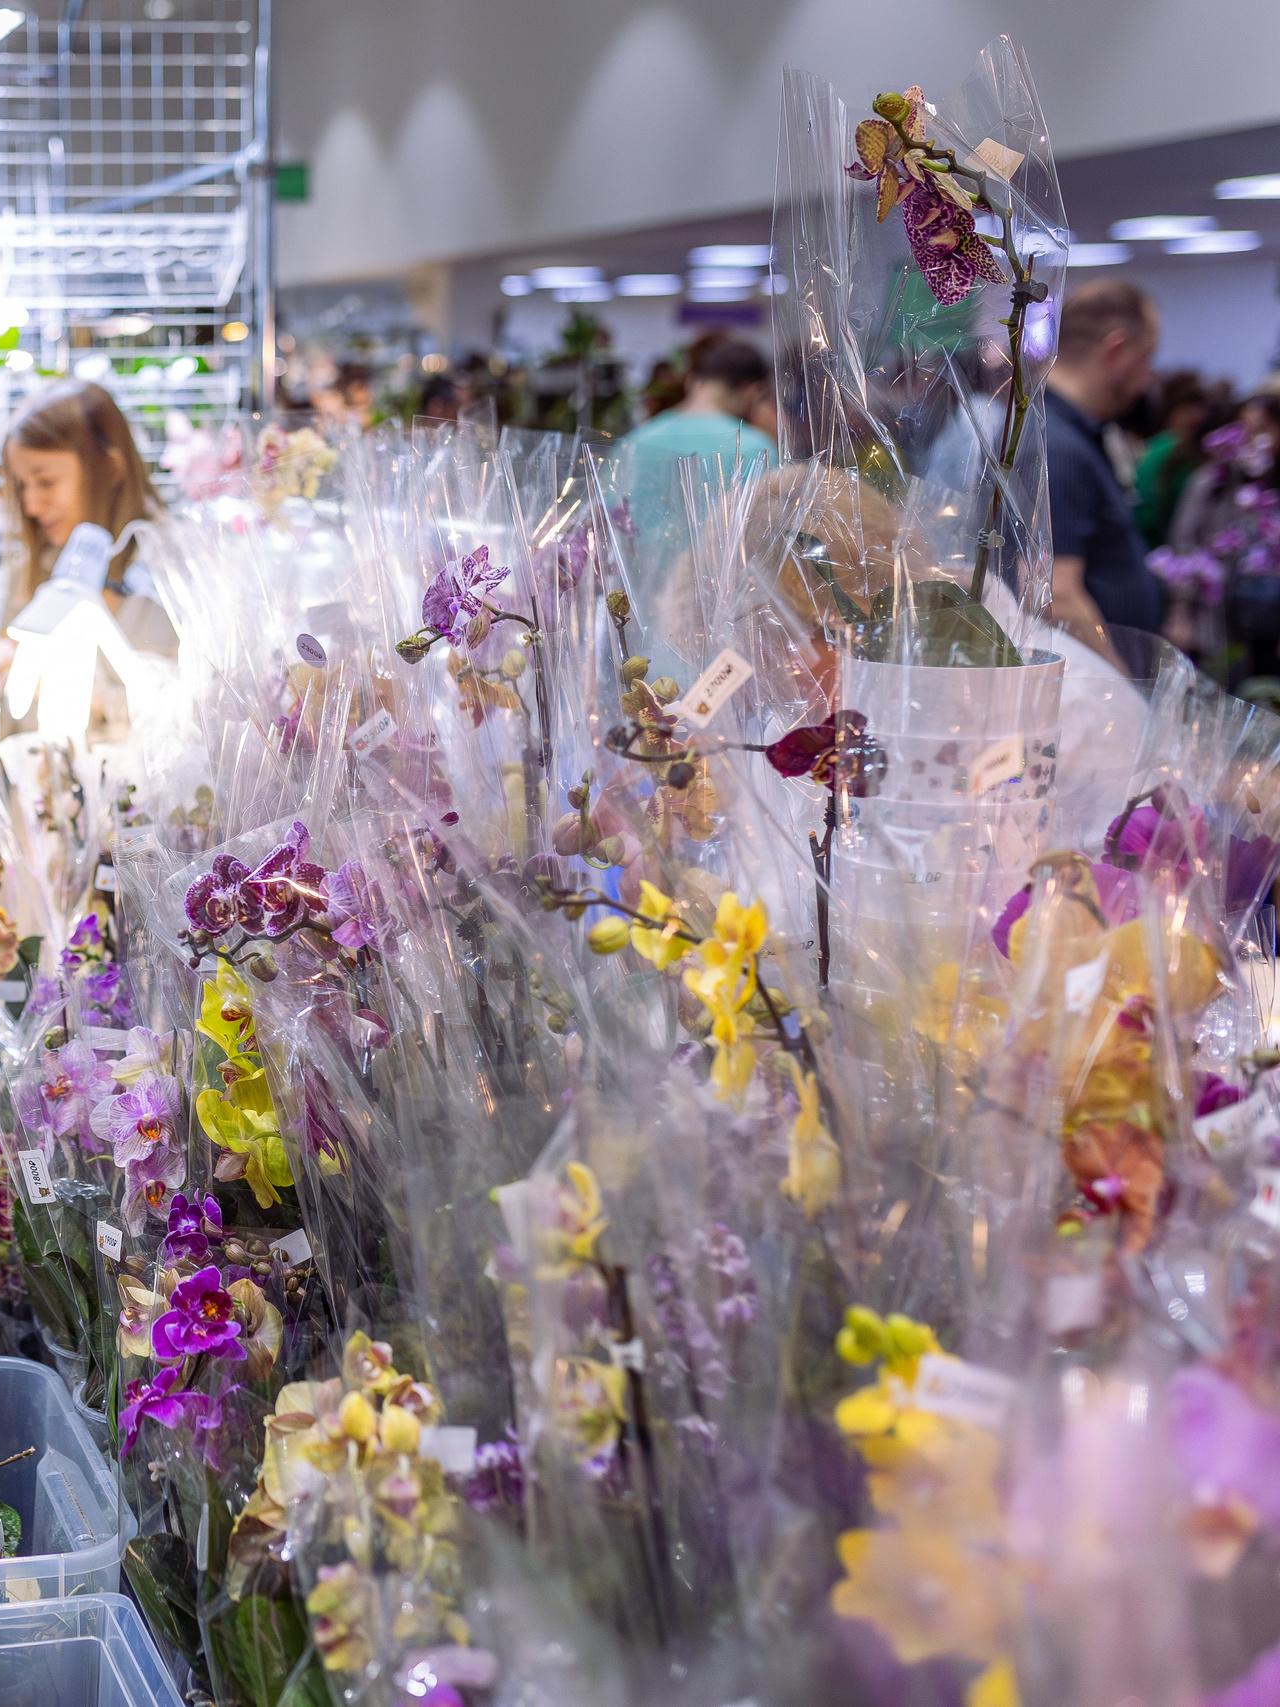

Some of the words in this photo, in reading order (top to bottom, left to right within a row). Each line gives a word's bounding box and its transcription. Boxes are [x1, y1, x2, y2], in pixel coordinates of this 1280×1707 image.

[301, 643, 323, 659] 2300₽
[364, 716, 391, 744] 2500₽
[905, 872, 942, 884] 30₽
[29, 1160, 41, 1185] 1800₽
[105, 1235, 118, 1247] 1900₽
